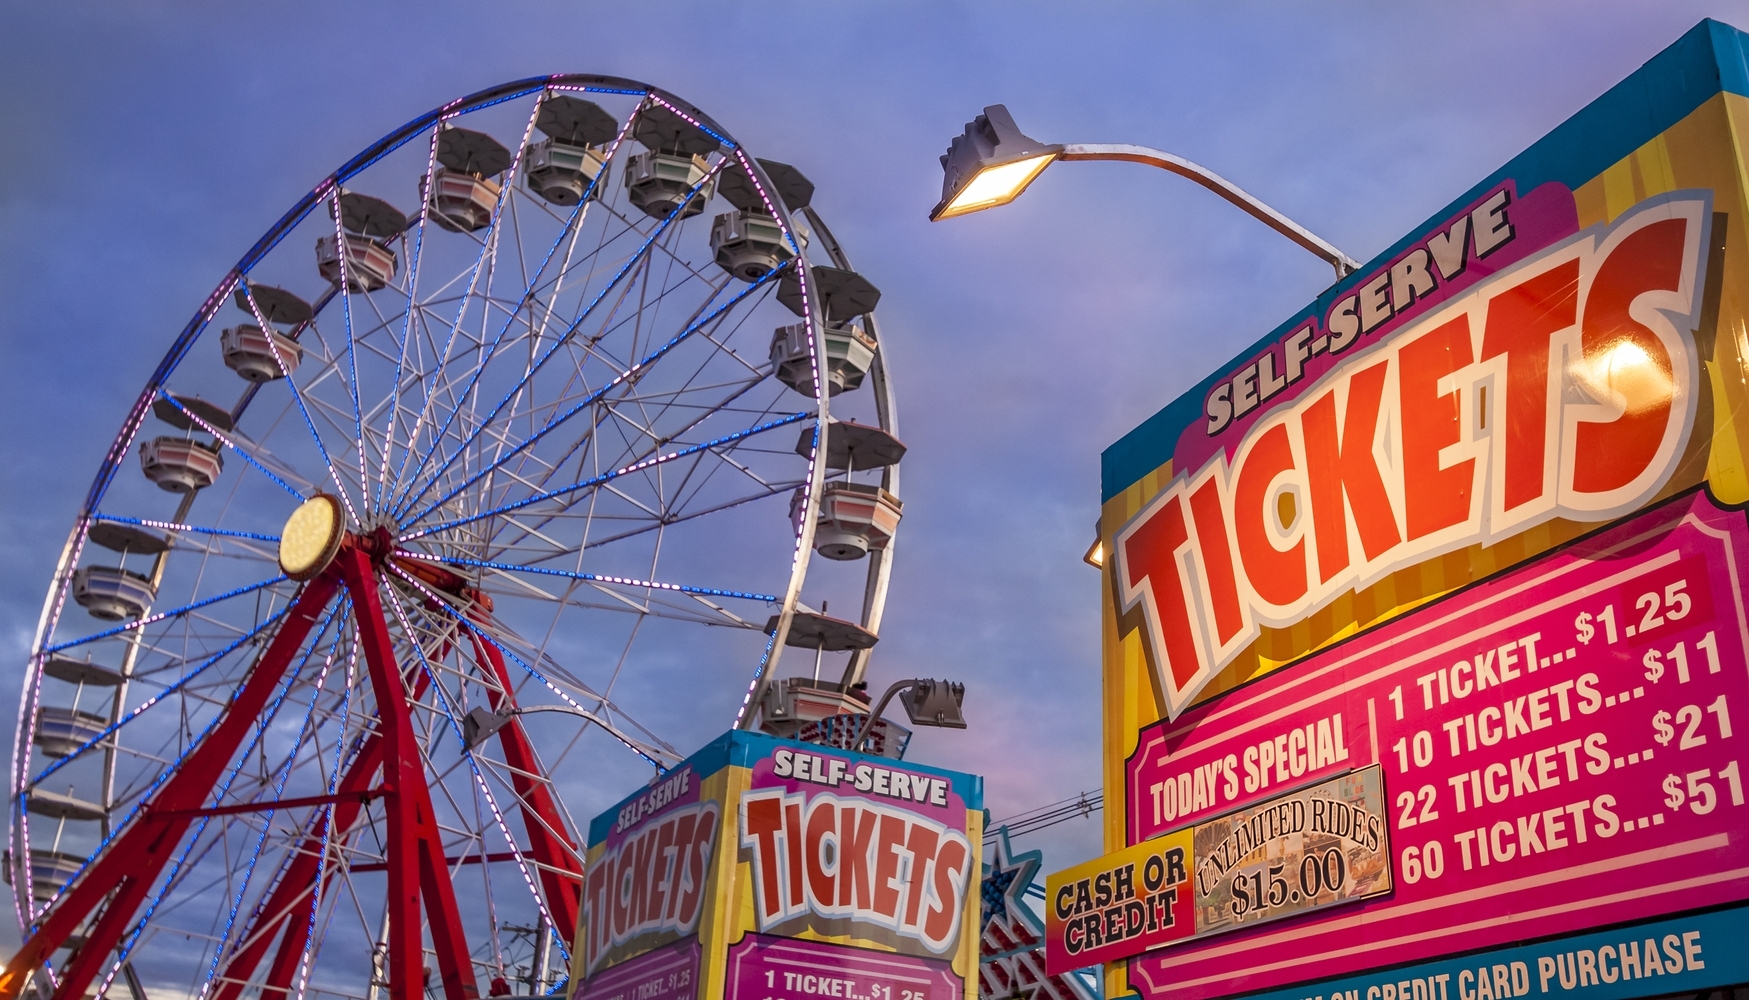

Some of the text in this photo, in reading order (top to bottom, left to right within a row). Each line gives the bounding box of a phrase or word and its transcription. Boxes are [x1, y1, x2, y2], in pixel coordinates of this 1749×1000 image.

[1206, 189, 1514, 437] SELF-SERVE
[1119, 204, 1702, 710] TICKETS
[1389, 685, 1404, 721] 1
[774, 750, 948, 805] SELF-SERVE
[1150, 713, 1348, 826] TODAY'S SPECIAL
[1393, 730, 1434, 774] 10
[617, 767, 692, 834] SELF-SERVE
[1396, 784, 1439, 830] 22
[743, 792, 969, 947] TICKETS
[1198, 799, 1380, 897] UNLIMITED RIDES
[1401, 840, 1444, 884] 60
[586, 806, 717, 970] TICKETS
[1056, 847, 1187, 920] CASH OR
[1231, 849, 1345, 919] $15.00
[1065, 889, 1177, 954] CREDIT
[765, 970, 775, 988] 1
[1458, 961, 1530, 1000] CARD
[1538, 931, 1705, 993] PURCHASE
